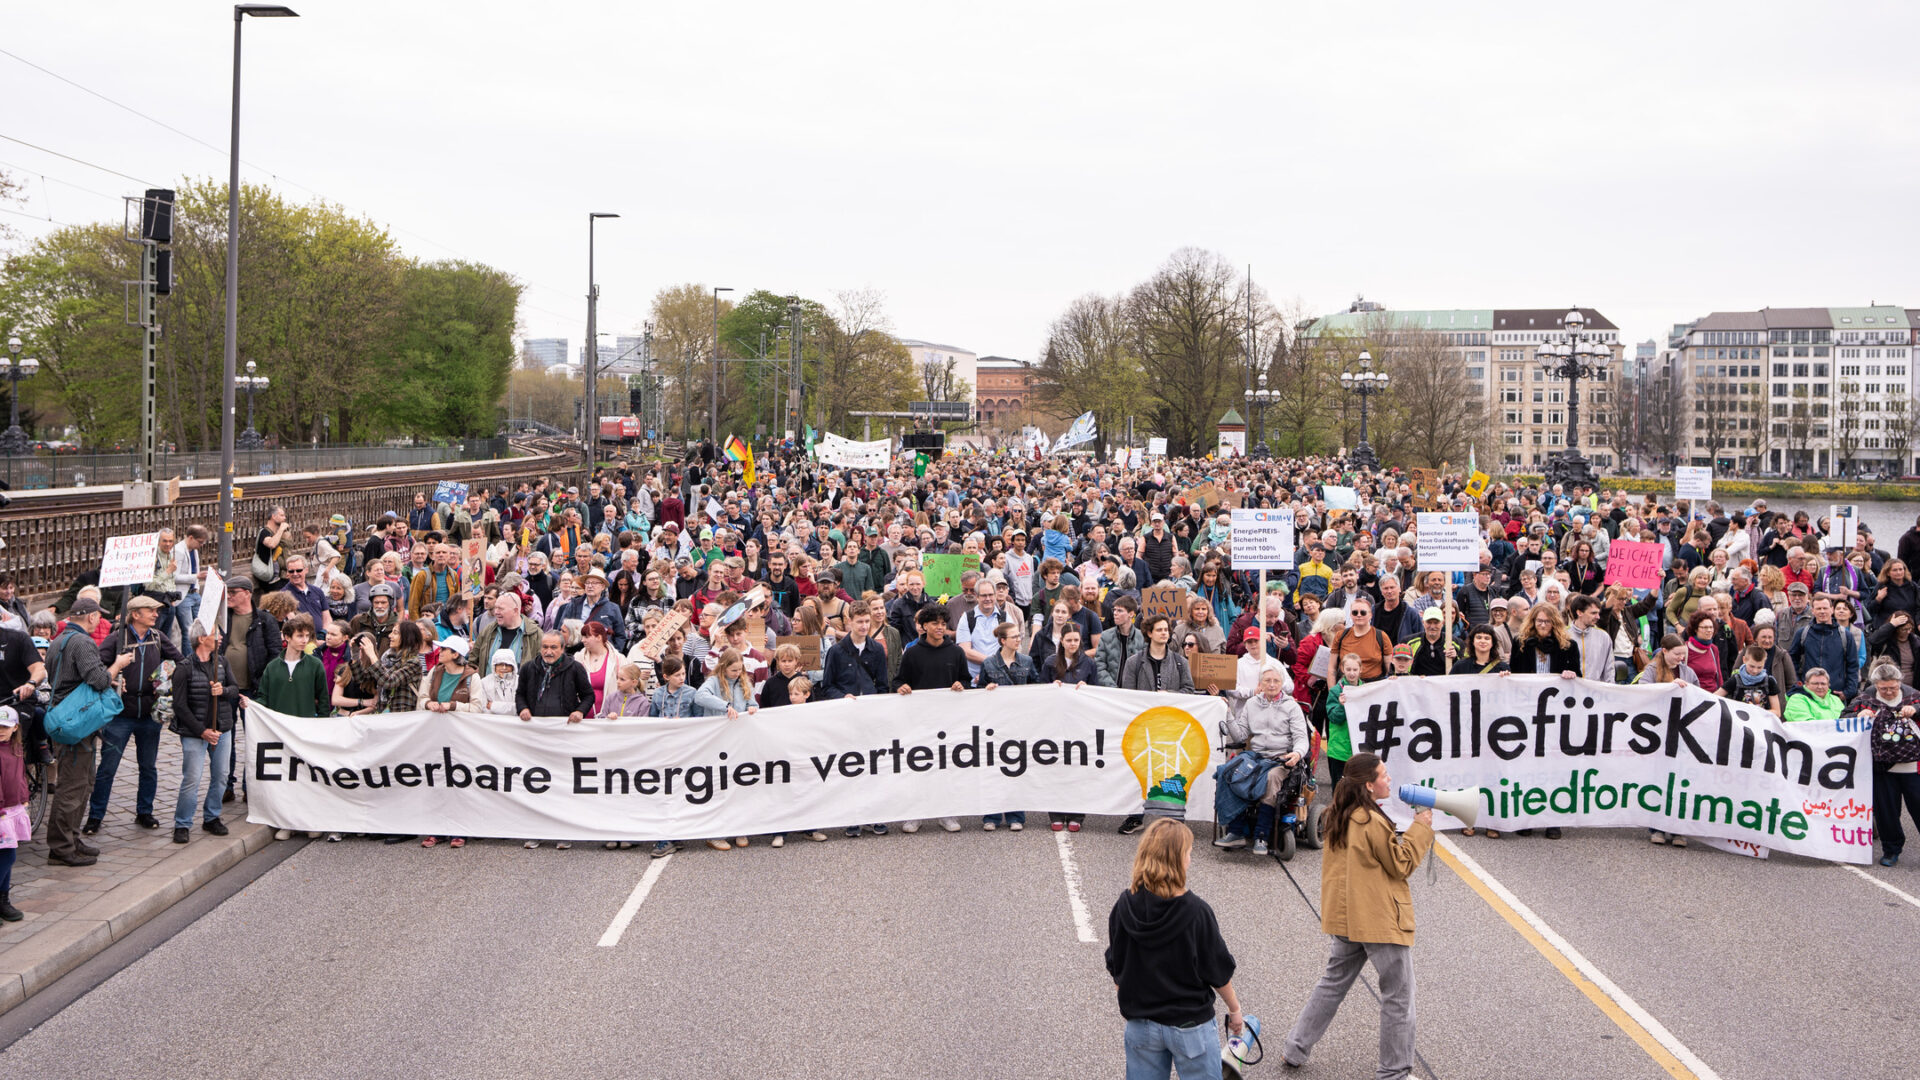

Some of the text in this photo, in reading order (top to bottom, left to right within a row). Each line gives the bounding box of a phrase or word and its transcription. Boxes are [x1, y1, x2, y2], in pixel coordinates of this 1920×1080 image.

[113, 534, 154, 549] REICHE
[1149, 590, 1178, 603] ACT
[811, 726, 1106, 782] verteidigen!
[1358, 686, 1857, 790] #allefürsKlima
[255, 742, 552, 794] Erneuerbare
[572, 752, 791, 804] Energien
[1411, 768, 1808, 841] nitedforclimate
